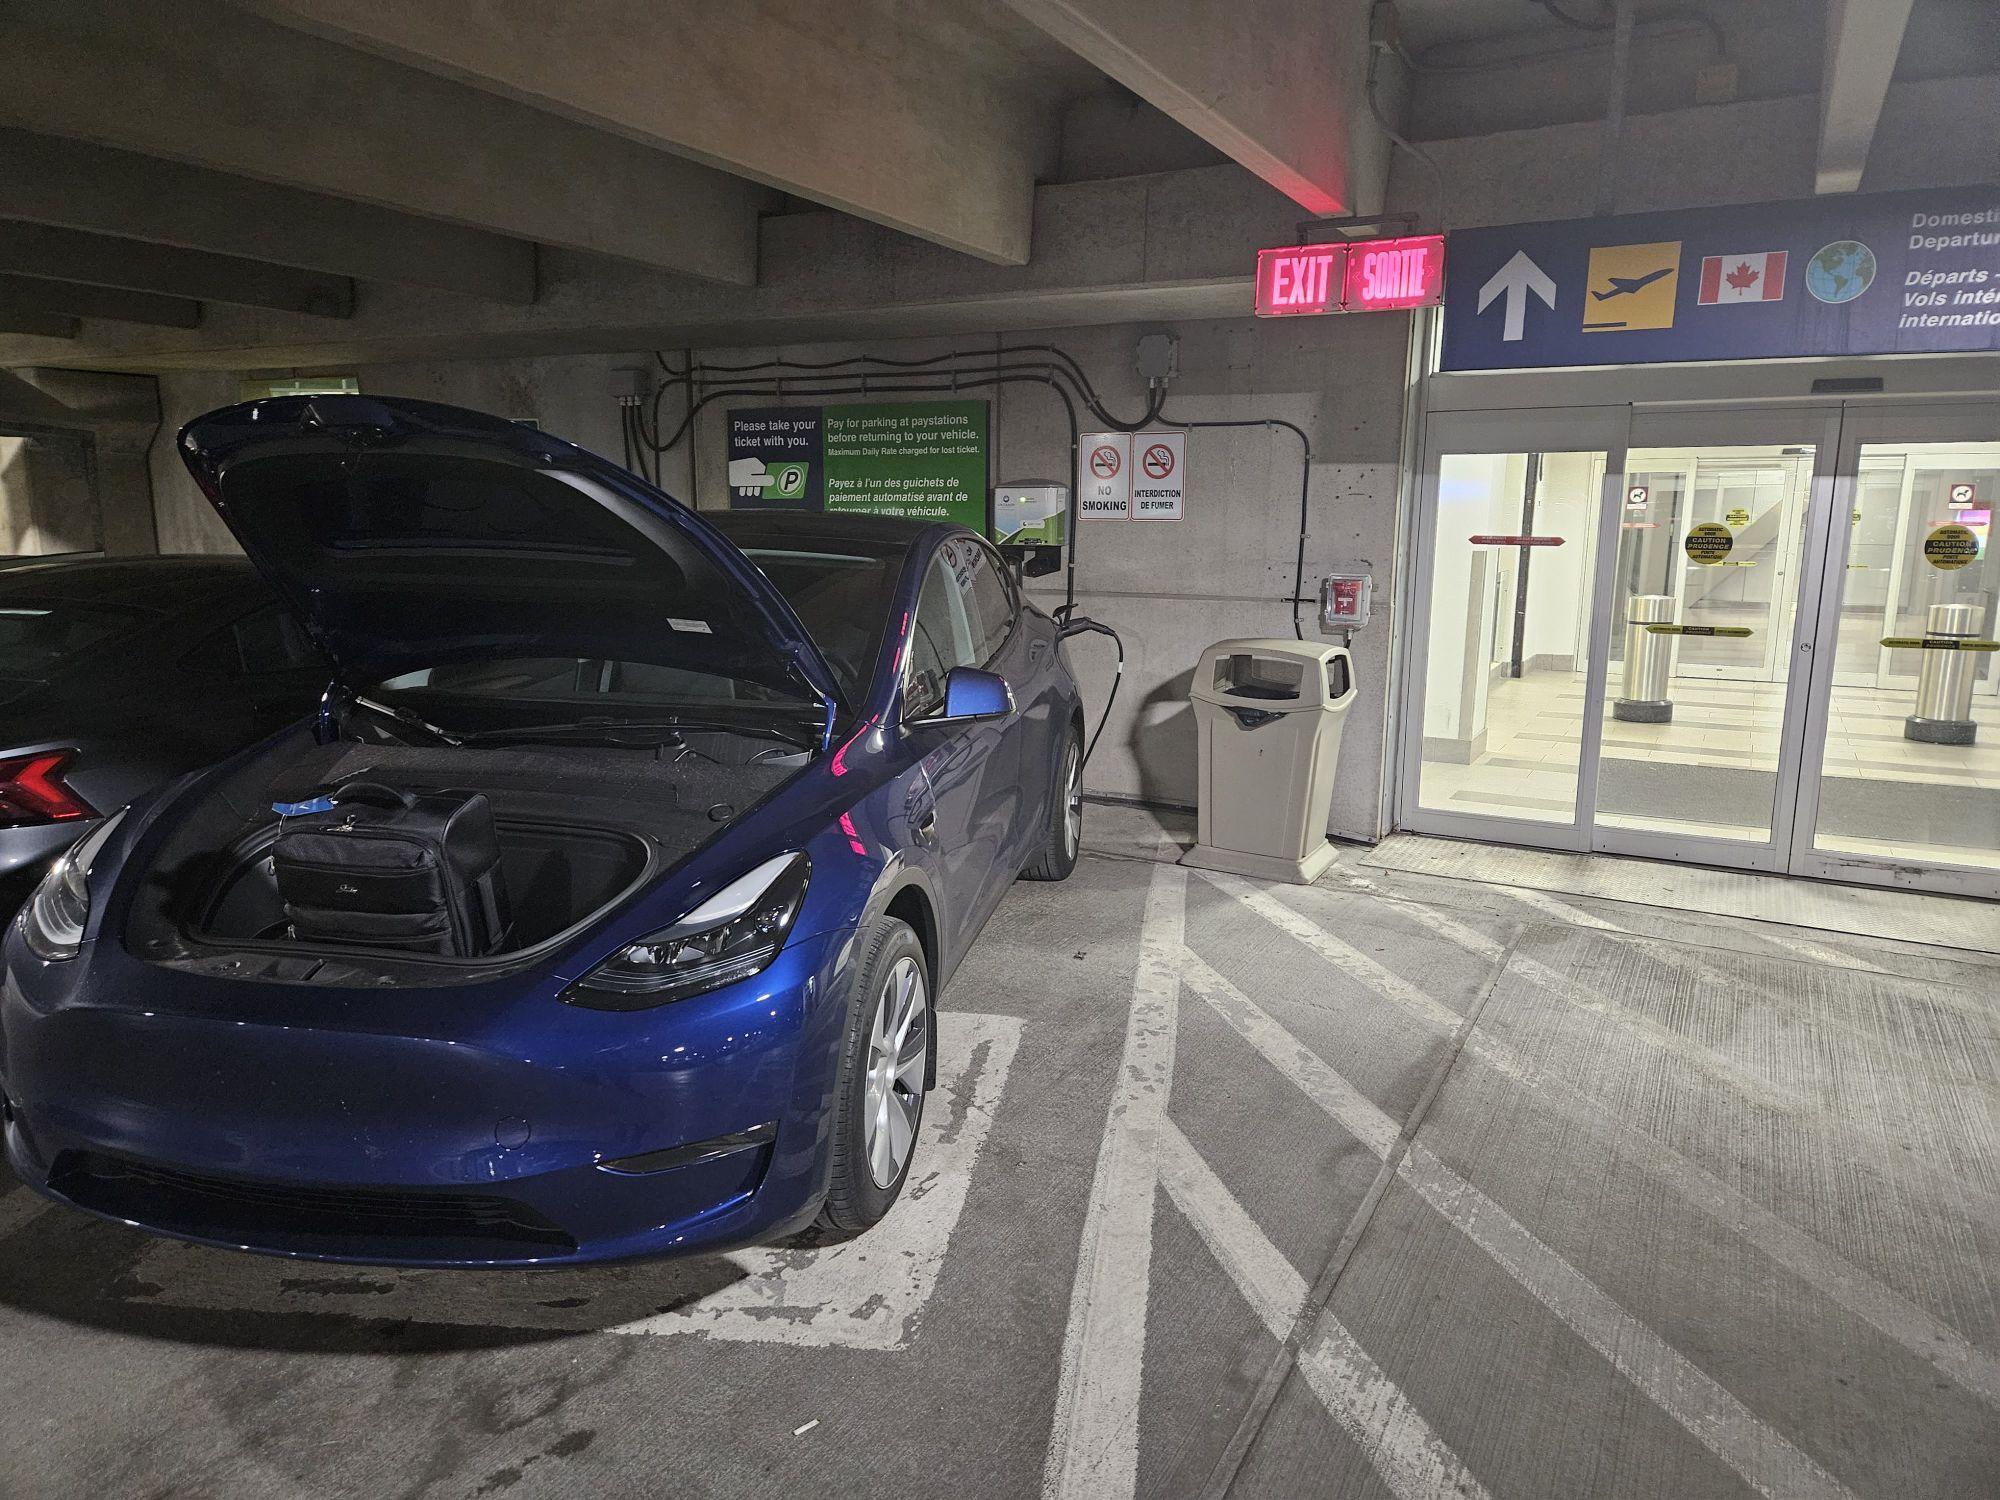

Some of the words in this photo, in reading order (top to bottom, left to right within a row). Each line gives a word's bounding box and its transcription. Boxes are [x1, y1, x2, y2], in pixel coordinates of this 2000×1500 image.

[1272, 255, 1334, 305] EXIT
[1362, 248, 1428, 301] SORTIE
[1904, 269, 1989, 288] Départs
[1905, 291, 1948, 307] Vols
[1898, 310, 2000, 329] internatio
[734, 420, 766, 432] Please
[769, 419, 790, 431] take
[793, 420, 816, 433] your
[827, 418, 844, 430] Pay
[847, 418, 859, 428] for
[862, 417, 897, 429] parking
[900, 417, 909, 426] at
[911, 414, 968, 428] paystations
[734, 436, 760, 447] ticket
[763, 435, 784, 446] with
[787, 437, 809, 449] you.
[828, 433, 857, 443] before
[859, 431, 902, 443] returning
[904, 432, 914, 441] to
[916, 432, 938, 443] your
[940, 429, 979, 440] vehicle.
[828, 448, 861, 456] Maximum
[862, 447, 879, 456] Daily
[881, 447, 897, 455] Rate
[898, 446, 928, 456] charged
[930, 446, 940, 454] for
[941, 446, 955, 454] lost
[957, 445, 980, 453] ticket.
[828, 478, 855, 490] Payez
[857, 477, 863, 488] à
[865, 477, 881, 488] l'un
[884, 477, 901, 487] des
[903, 477, 945, 490] guichets
[946, 476, 959, 487] de
[828, 492, 871, 504] paiement
[873, 491, 925, 502] automatisé
[926, 492, 953, 502] avant
[955, 491, 968, 502] de
[1098, 486, 1112, 496] NO
[1134, 489, 1181, 498] INTERDICTION
[881, 506, 905, 516] votre
[907, 505, 950, 516] véhicule.
[1082, 501, 1127, 511] SMOKING
[1140, 501, 1150, 510] DE
[1151, 501, 1174, 510] FUMER
